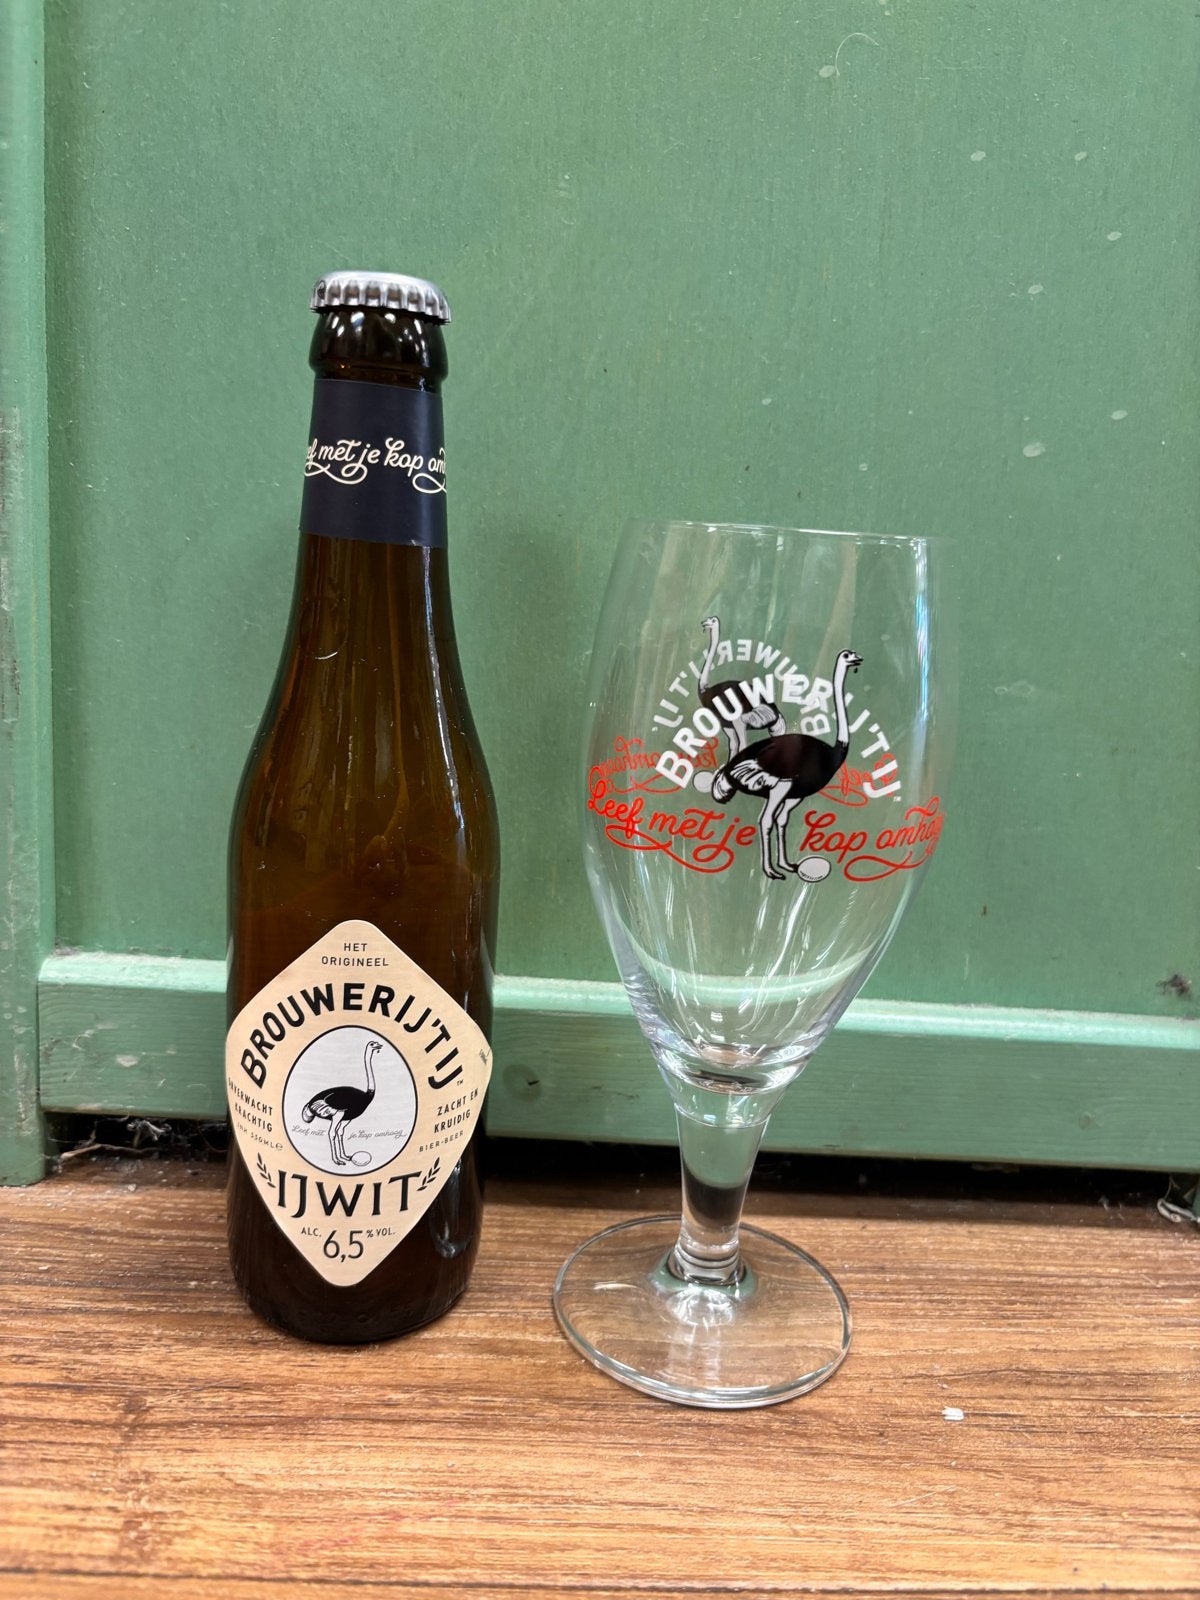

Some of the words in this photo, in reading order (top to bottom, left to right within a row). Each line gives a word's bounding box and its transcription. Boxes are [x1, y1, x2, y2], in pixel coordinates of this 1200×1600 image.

[318, 439, 362, 461] met
[341, 443, 381, 478] je
[384, 437, 424, 477] kop
[588, 780, 644, 839] Leef
[649, 808, 726, 841] met
[692, 817, 757, 872] je
[801, 810, 868, 864] kop
[343, 942, 367, 952] HET
[321, 956, 389, 967] ORIGINEEL
[235, 1102, 273, 1133] KRACHTIG
[437, 1095, 467, 1116] ZACHT
[433, 1109, 471, 1134] KRUIDIG
[419, 1130, 464, 1153] BIER-BEER
[277, 1170, 423, 1219] IJWIT
[301, 1227, 322, 1237] ALC.
[376, 1227, 396, 1237] VOL.
